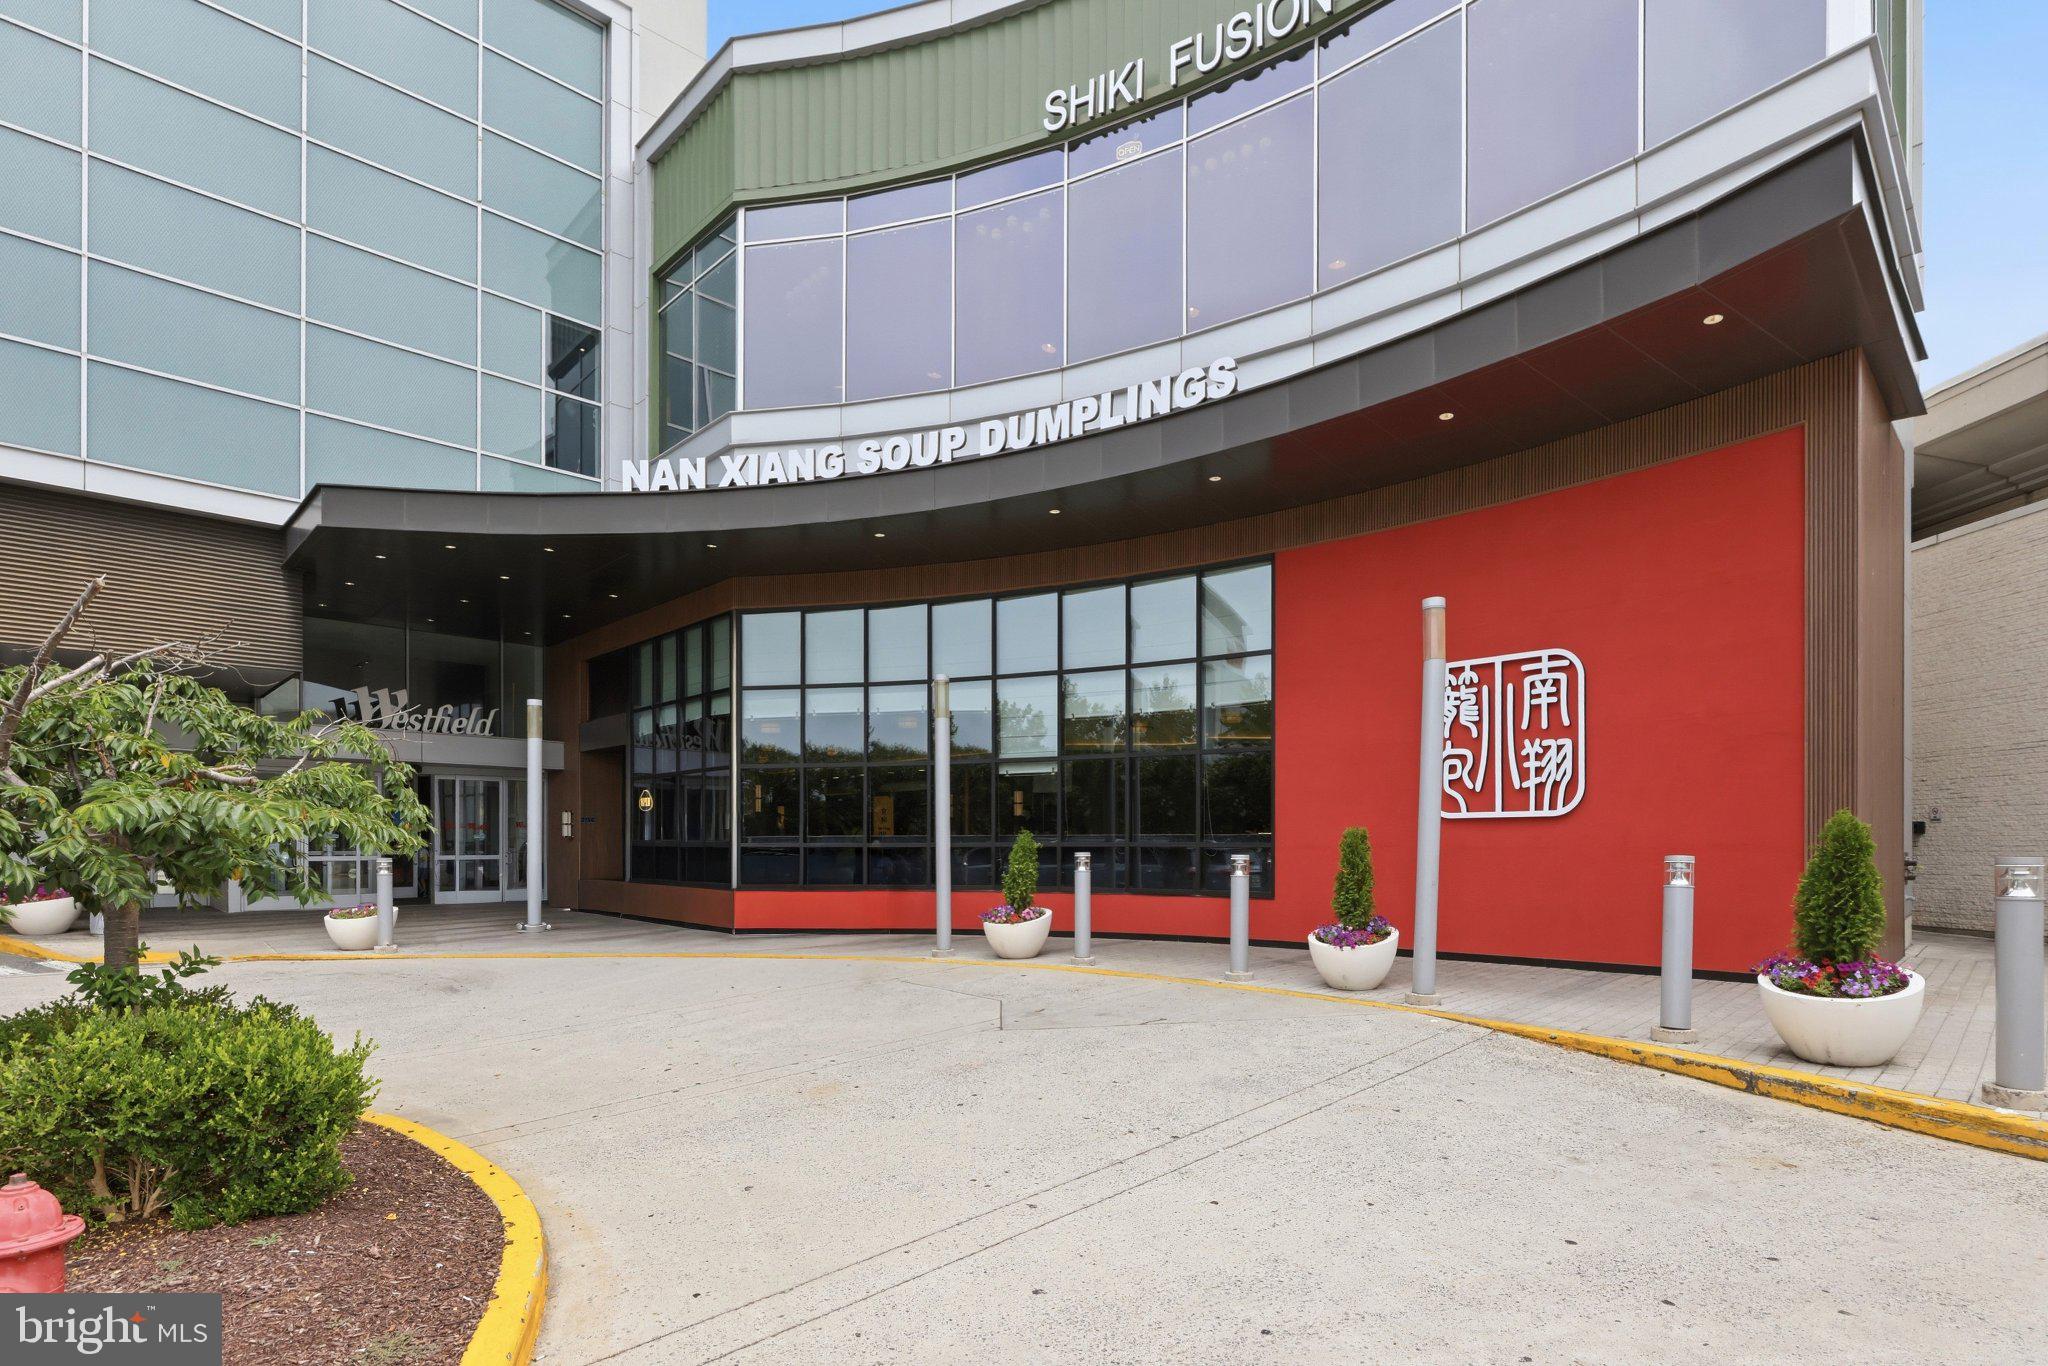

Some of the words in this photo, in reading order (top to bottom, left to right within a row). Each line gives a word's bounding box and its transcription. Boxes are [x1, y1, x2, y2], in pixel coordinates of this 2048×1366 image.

[1043, 58, 1144, 132] SHIKI
[1118, 144, 1140, 157] OPEN
[622, 457, 707, 492] NAN
[718, 445, 846, 488] XIANG
[857, 426, 967, 475] SOUP
[979, 356, 1239, 457] DUMPLINGS
[350, 685, 500, 737] Westfield
